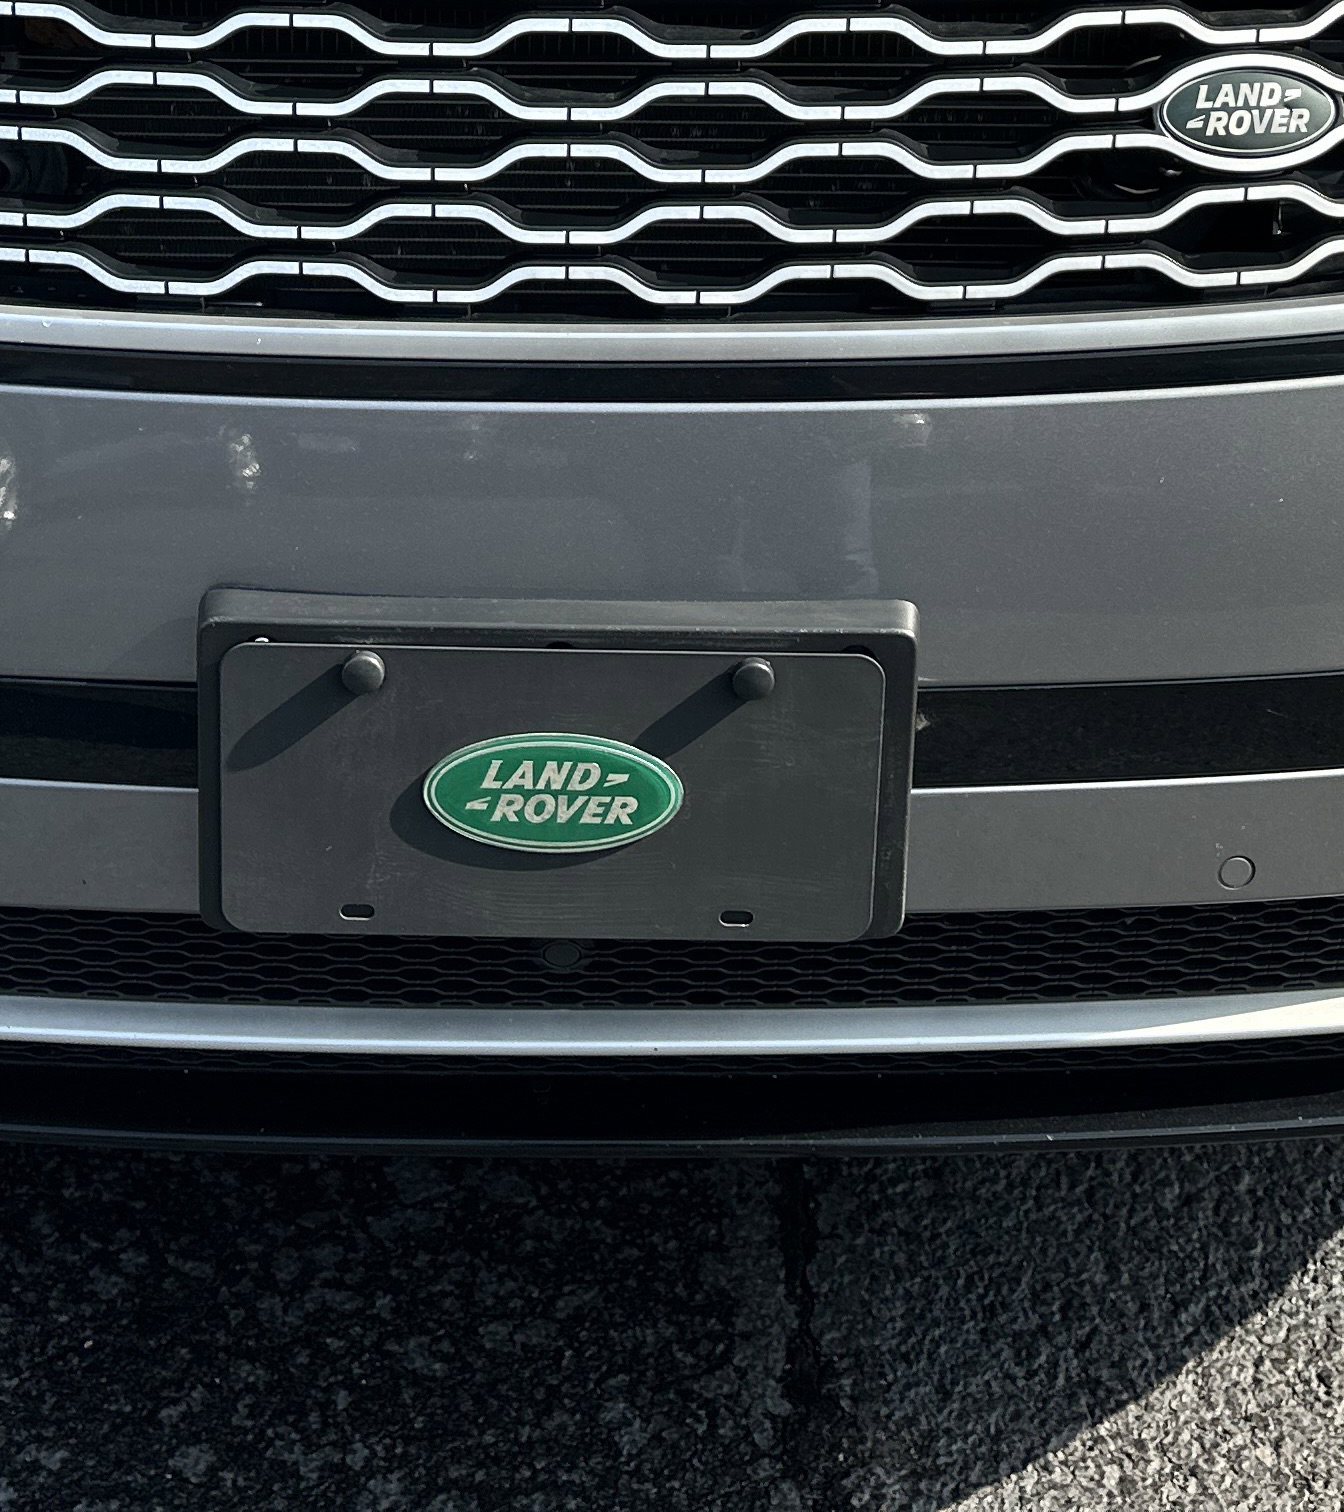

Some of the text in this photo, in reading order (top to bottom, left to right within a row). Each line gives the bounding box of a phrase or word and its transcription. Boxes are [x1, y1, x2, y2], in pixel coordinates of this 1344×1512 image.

[1195, 82, 1282, 110] LAND
[1205, 107, 1311, 137] ROVER
[480, 759, 602, 791] LAND
[489, 793, 639, 826] ROVER
